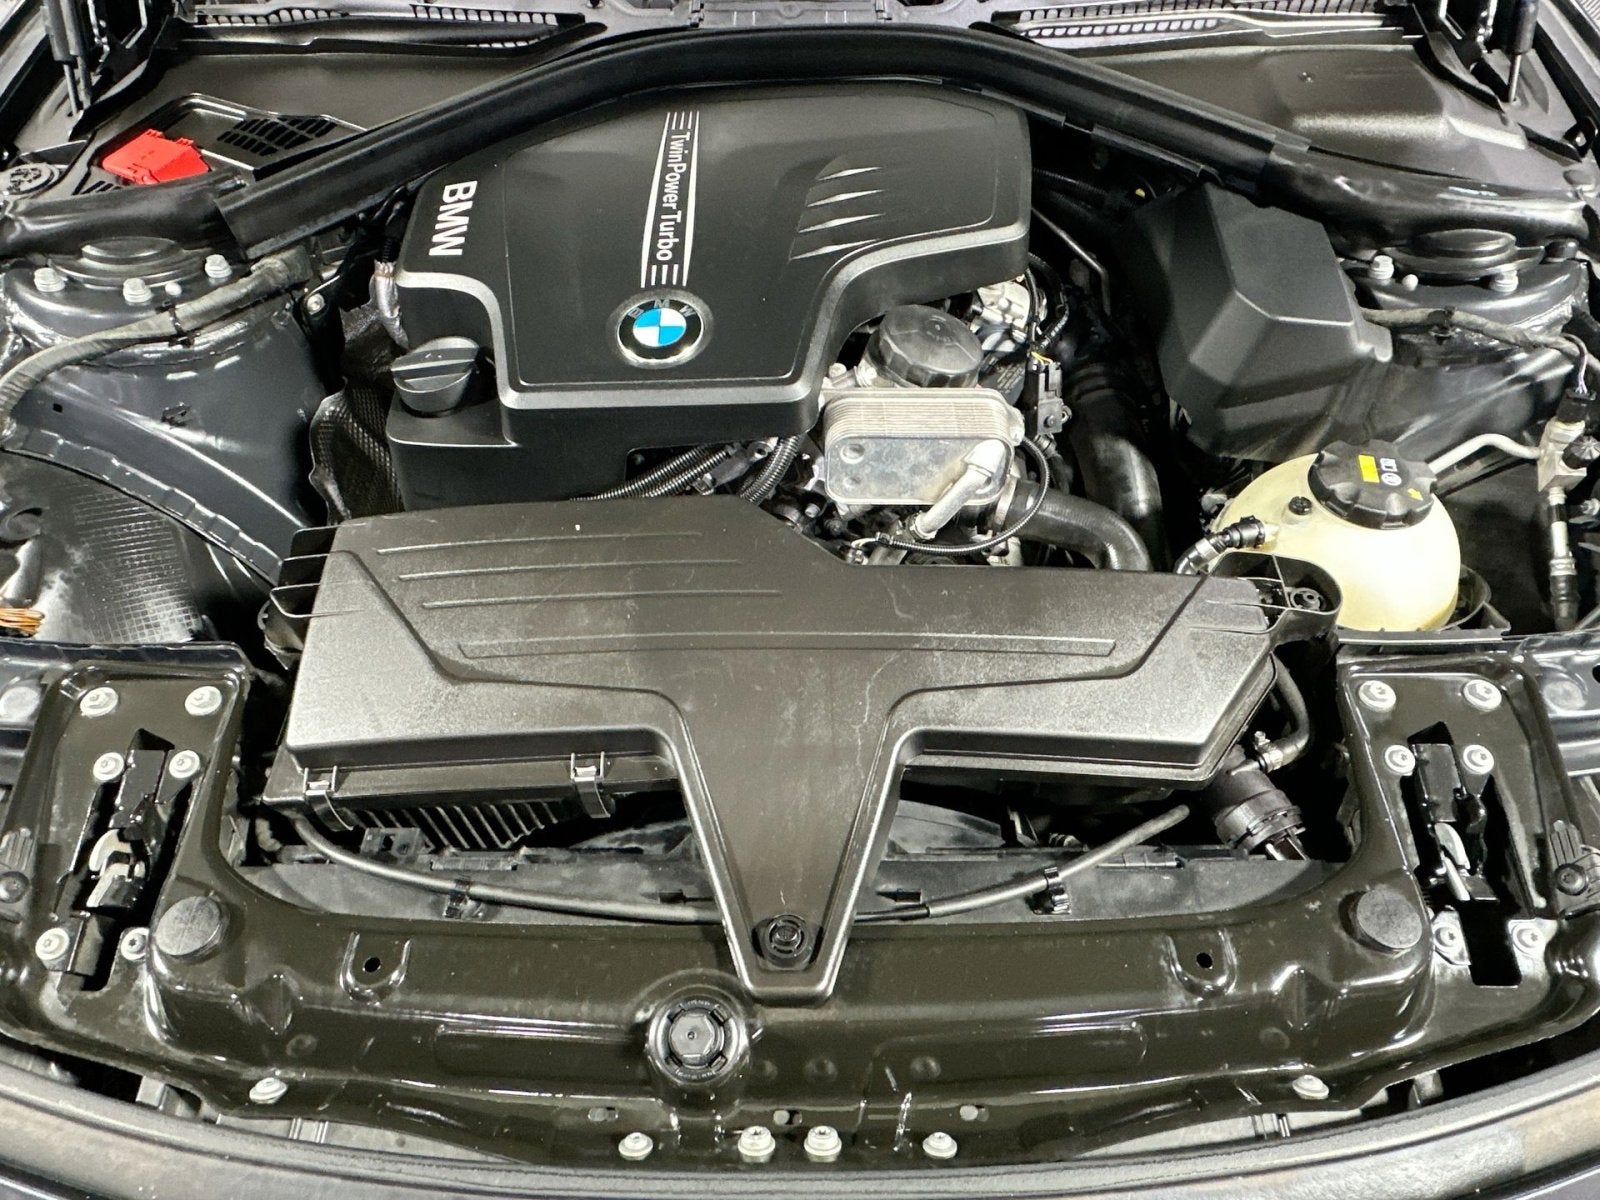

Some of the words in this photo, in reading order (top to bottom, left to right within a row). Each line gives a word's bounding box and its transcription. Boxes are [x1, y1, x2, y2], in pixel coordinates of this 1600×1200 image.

[662, 131, 691, 210] TwinPower
[428, 180, 478, 256] BMW
[656, 210, 682, 261] Turbo
[627, 298, 697, 319] BMW
